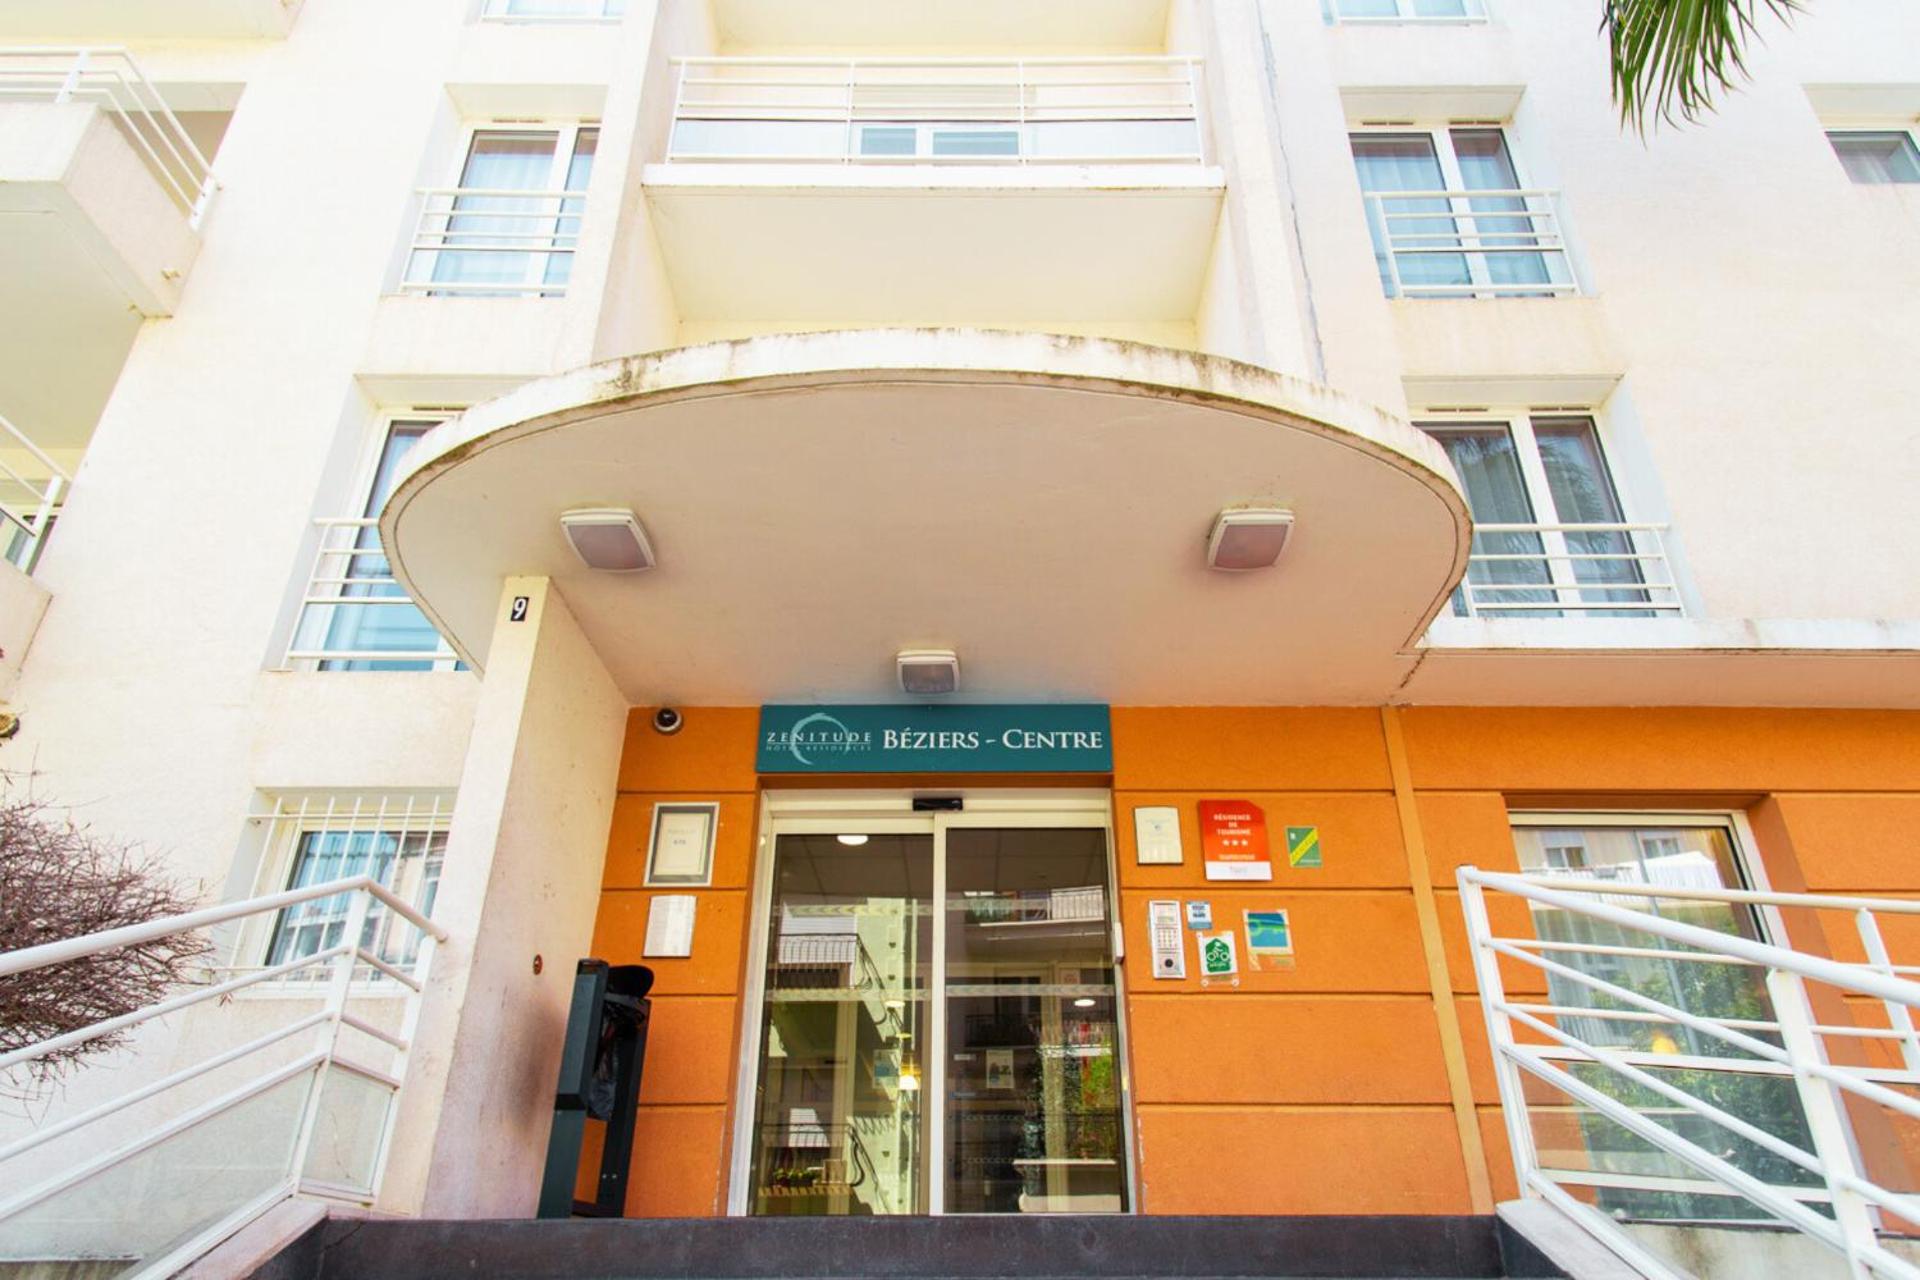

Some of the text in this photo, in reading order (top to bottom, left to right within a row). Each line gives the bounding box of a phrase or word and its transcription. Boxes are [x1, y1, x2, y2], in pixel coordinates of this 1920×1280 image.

[513, 598, 527, 620] 9
[767, 731, 872, 742] ZENITUDE
[882, 727, 980, 750] BÉZIERS
[1002, 728, 1104, 750] CENTRE
